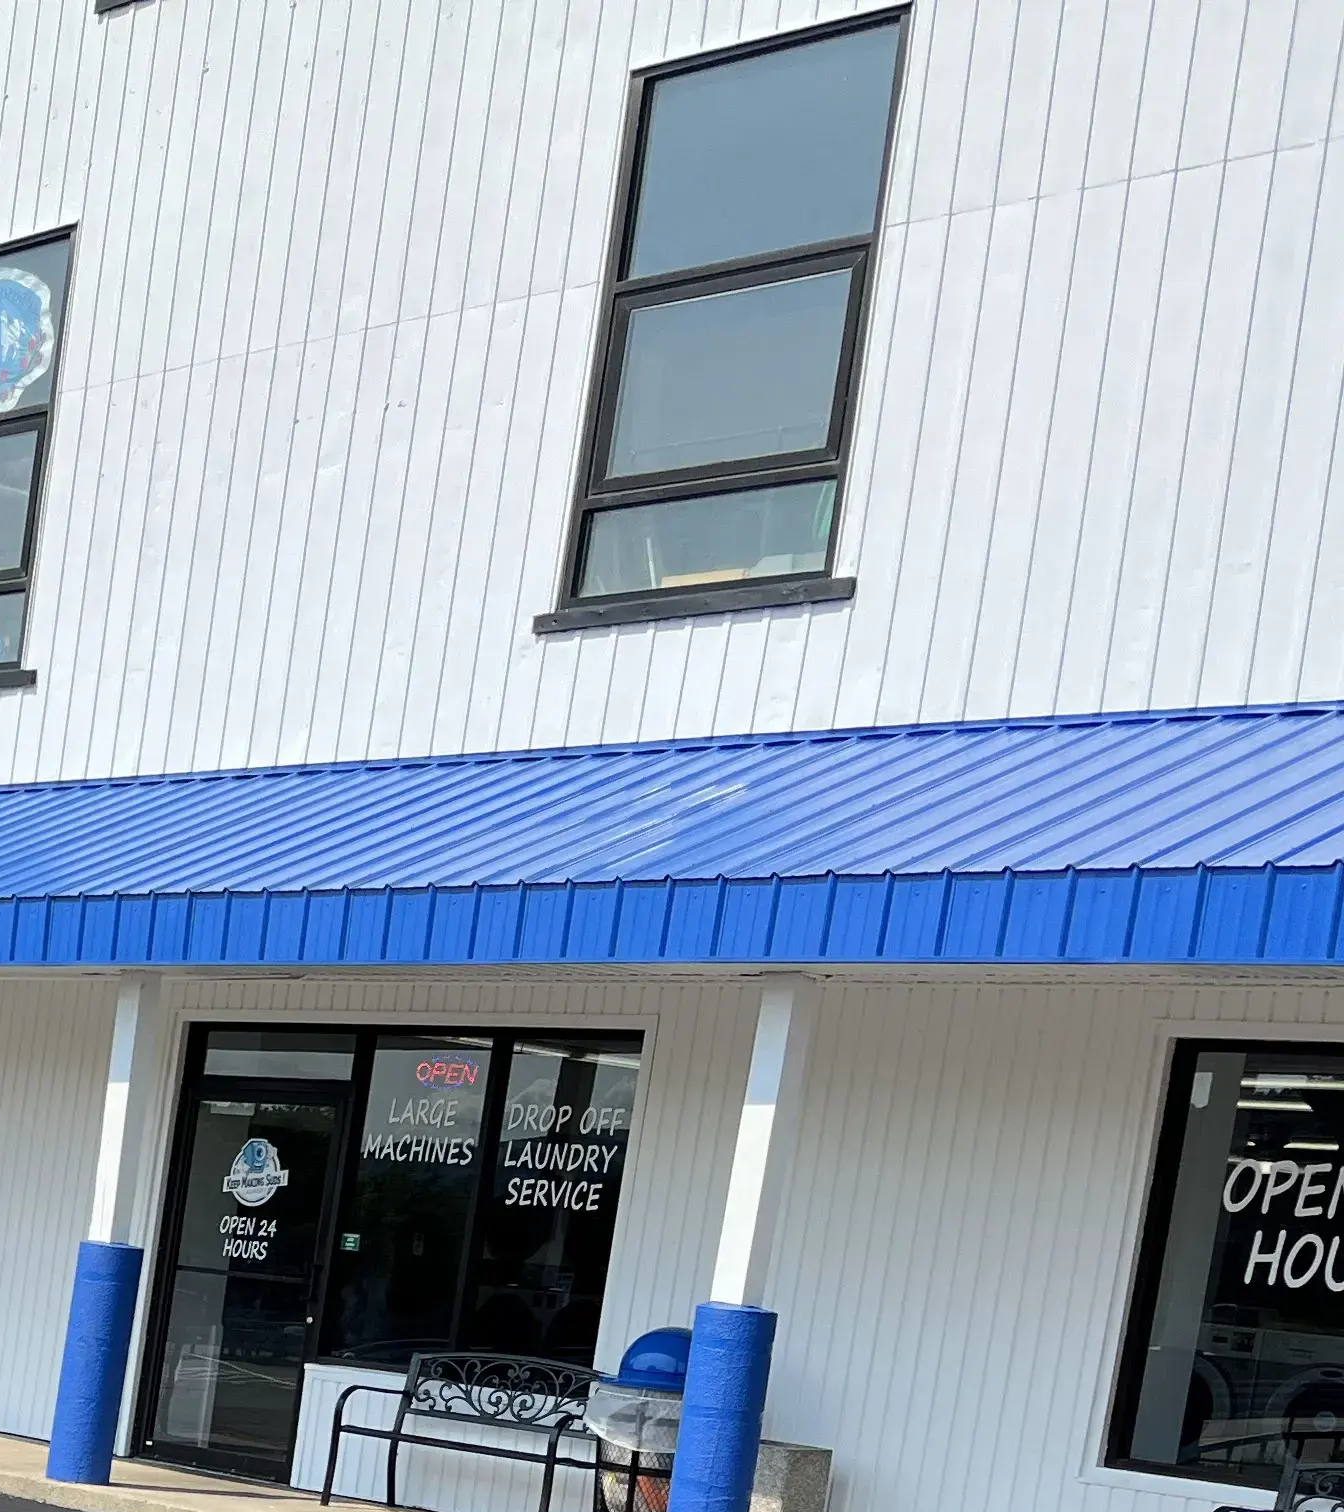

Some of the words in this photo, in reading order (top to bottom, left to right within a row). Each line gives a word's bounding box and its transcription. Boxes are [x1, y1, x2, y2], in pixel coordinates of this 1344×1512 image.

[415, 1060, 480, 1085] OPEN
[388, 1098, 459, 1129] LARGE
[507, 1103, 573, 1133] DROP
[579, 1106, 626, 1136] OFF
[363, 1133, 475, 1166] MACHINES
[504, 1140, 618, 1174] LAUNDRY
[504, 1177, 603, 1211] SERVICE
[219, 1215, 257, 1236] OPEN
[257, 1219, 277, 1238] 24
[222, 1238, 268, 1260] HOURS
